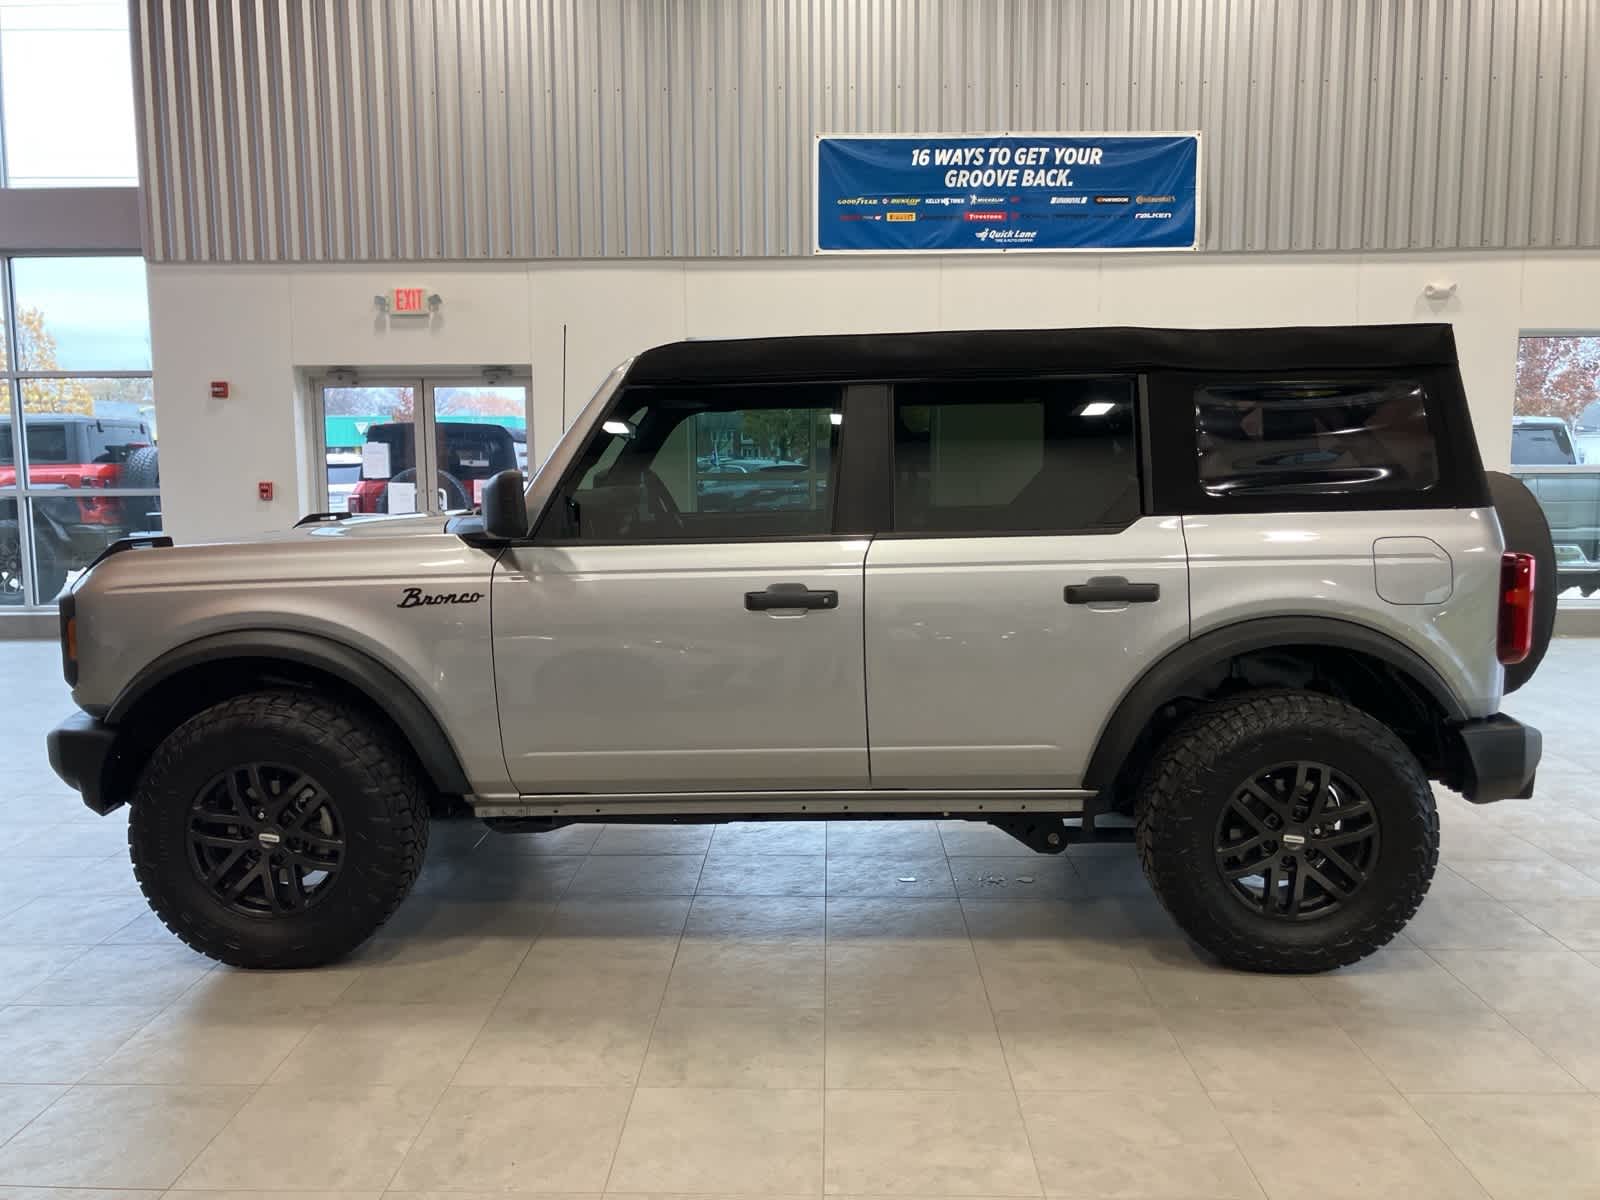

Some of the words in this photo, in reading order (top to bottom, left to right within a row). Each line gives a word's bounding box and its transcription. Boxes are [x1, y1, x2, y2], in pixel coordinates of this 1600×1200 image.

[911, 149, 930, 166] 16
[934, 148, 985, 166] WAYS
[988, 147, 1011, 166] TO
[1014, 147, 1050, 166] GET
[1053, 147, 1103, 165] YOUR
[944, 169, 1019, 188] GROOVE
[1021, 168, 1074, 187] BACK.
[837, 197, 878, 206] GOODYEAR
[988, 229, 1014, 239] Quick
[1013, 230, 1037, 238] Lane
[395, 288, 422, 311] EXIT
[396, 587, 485, 608] Bronco
